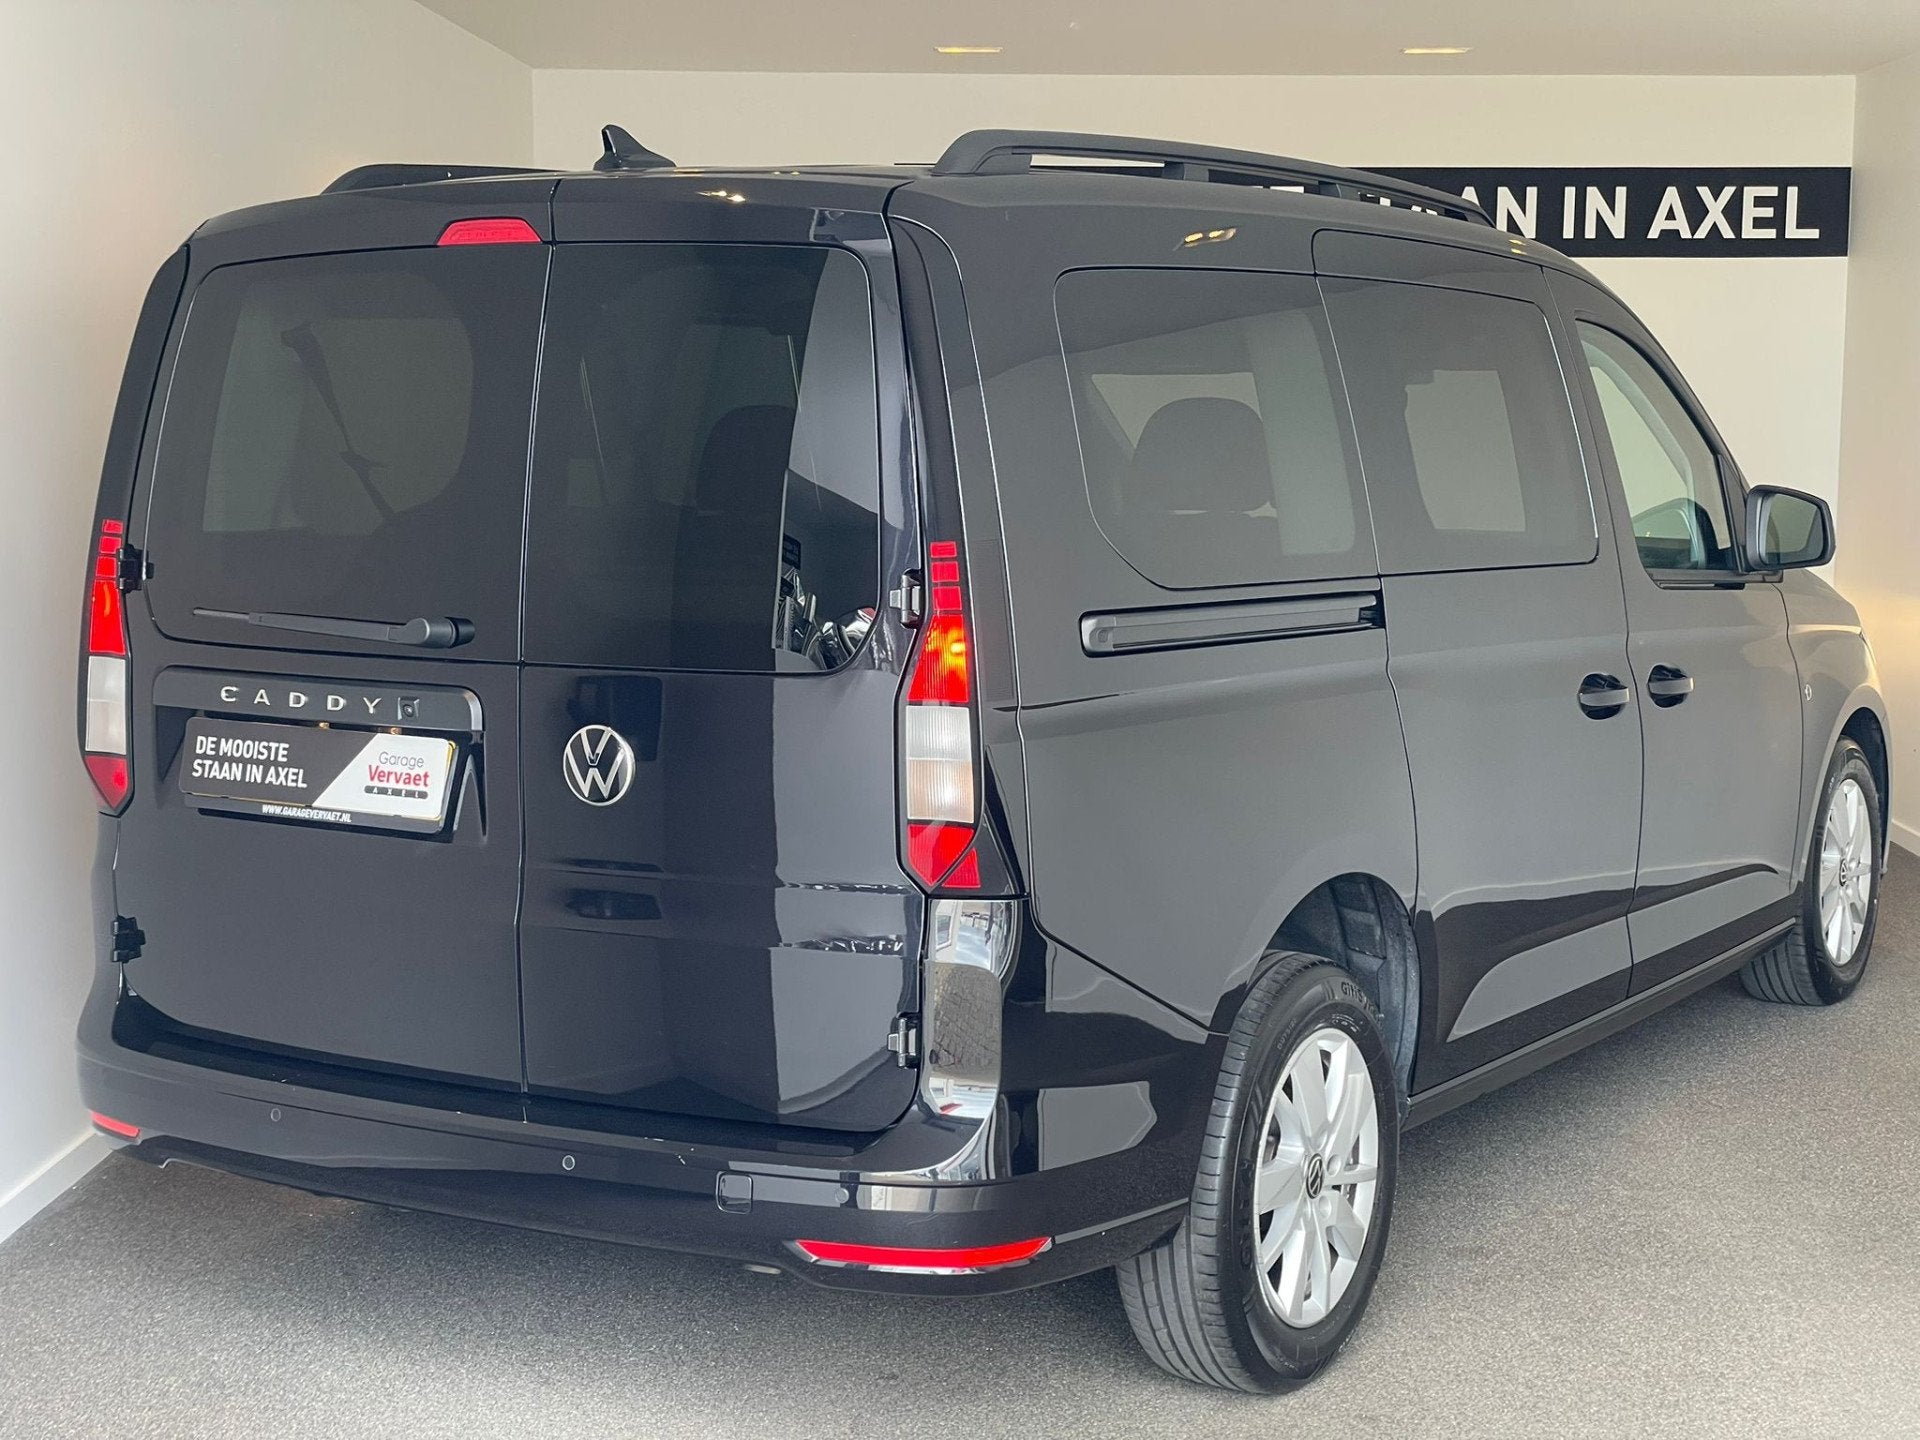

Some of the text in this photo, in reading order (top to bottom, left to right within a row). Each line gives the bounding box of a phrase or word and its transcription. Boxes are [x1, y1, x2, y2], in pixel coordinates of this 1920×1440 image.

[1562, 186, 1627, 239] IN
[1646, 186, 1820, 239] AXEL
[220, 685, 382, 714] CADDY
[195, 735, 290, 762] DE MOOISTE
[379, 751, 424, 770] Garage
[191, 758, 308, 788] STAAN IN AXEL
[368, 764, 430, 787] Vervaet
[261, 804, 352, 823] WWW.GARAGEVERVAET.NL
